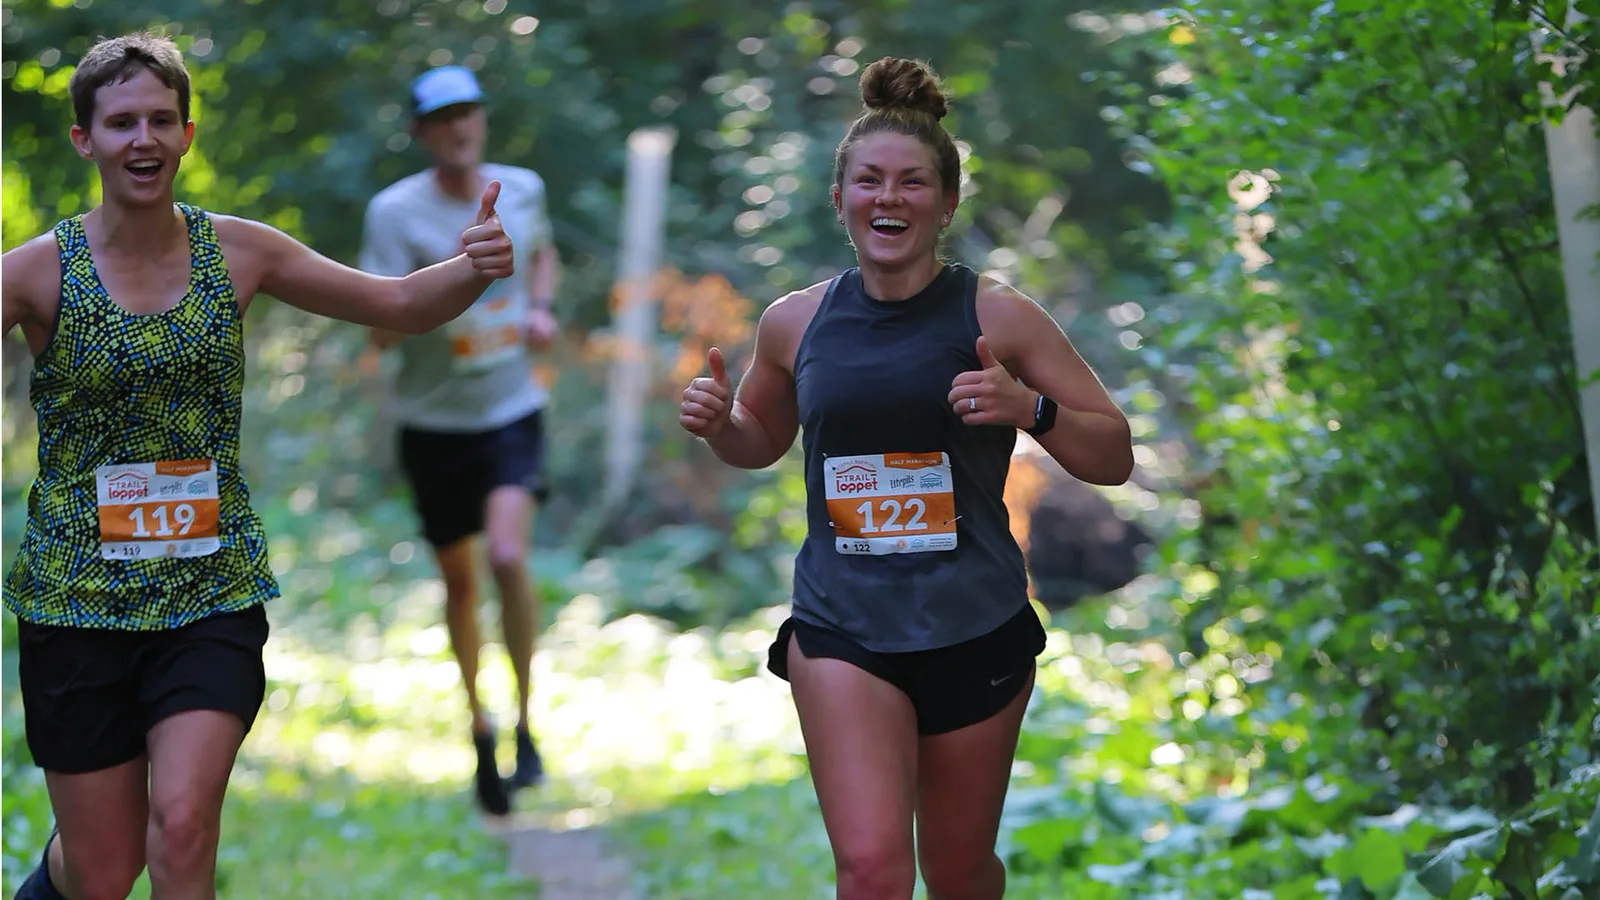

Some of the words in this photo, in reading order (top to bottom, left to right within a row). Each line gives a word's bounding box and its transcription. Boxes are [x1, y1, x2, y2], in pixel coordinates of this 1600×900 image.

[844, 474, 870, 482] TRAIL
[116, 480, 141, 489] TRAIL
[837, 477, 877, 493] loppet
[108, 485, 148, 499] loppet
[128, 503, 195, 537] 119
[856, 498, 928, 534] 122
[123, 546, 140, 555] 119
[853, 543, 871, 552] 122
